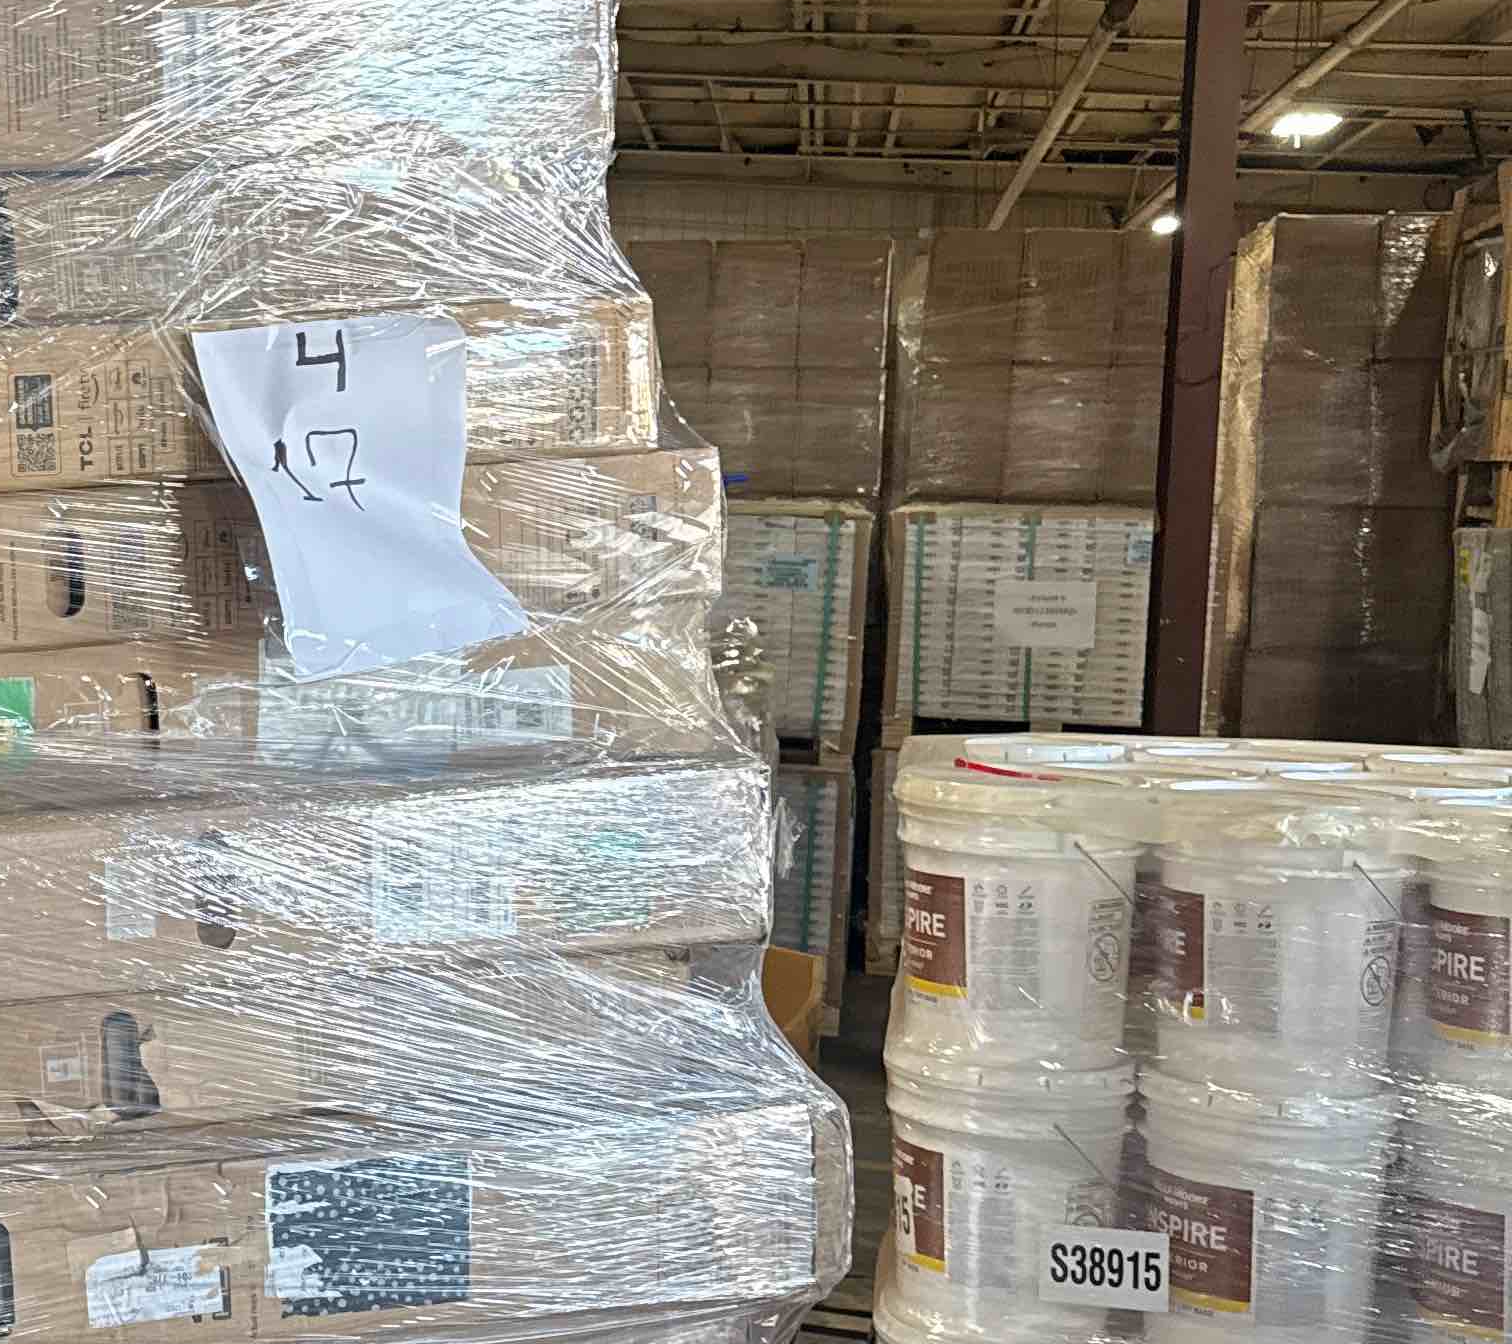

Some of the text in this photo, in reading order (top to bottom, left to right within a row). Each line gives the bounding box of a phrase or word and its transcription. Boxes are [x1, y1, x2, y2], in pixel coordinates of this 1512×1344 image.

[295, 328, 347, 392] 4
[79, 426, 93, 471] TCL
[1049, 1243, 1162, 1292] S38915
